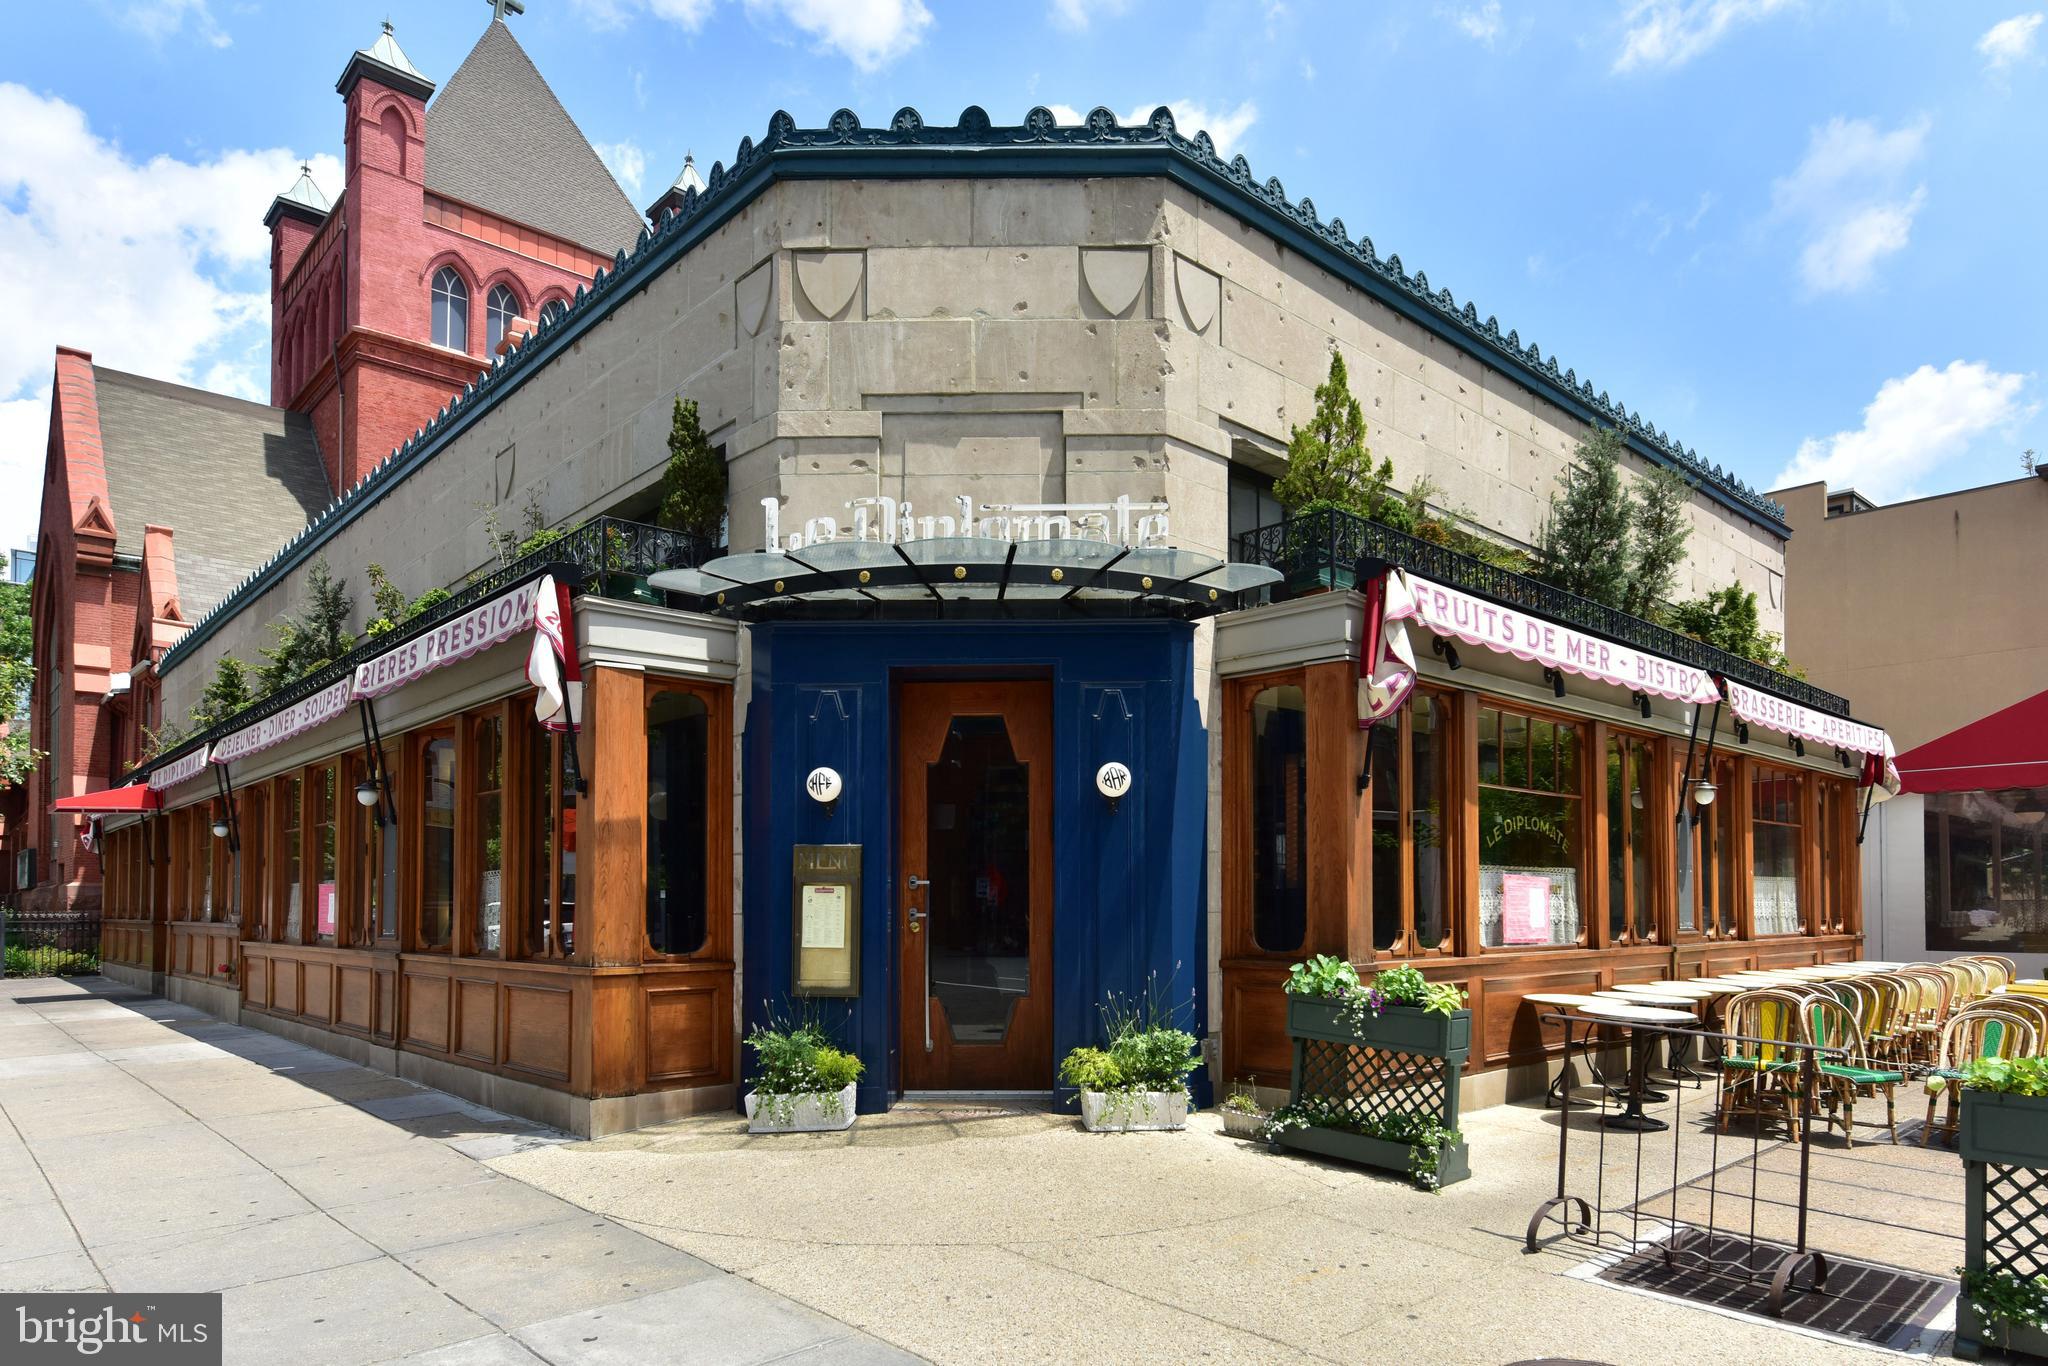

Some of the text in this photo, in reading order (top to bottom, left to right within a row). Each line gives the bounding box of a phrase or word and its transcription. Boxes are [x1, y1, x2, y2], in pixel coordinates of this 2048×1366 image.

[761, 497, 837, 553] Le
[425, 588, 531, 663] PRESSION
[1413, 583, 1514, 642] FRUITS
[1527, 621, 1556, 653] DE
[1566, 634, 1611, 671] MER
[1637, 657, 1700, 695] BISTRO
[304, 682, 348, 722] SOUPER
[1731, 686, 1806, 729] BRASSERIE
[1103, 766, 1127, 790] BAR
[1486, 815, 1571, 855] LE DIPLOMATE
